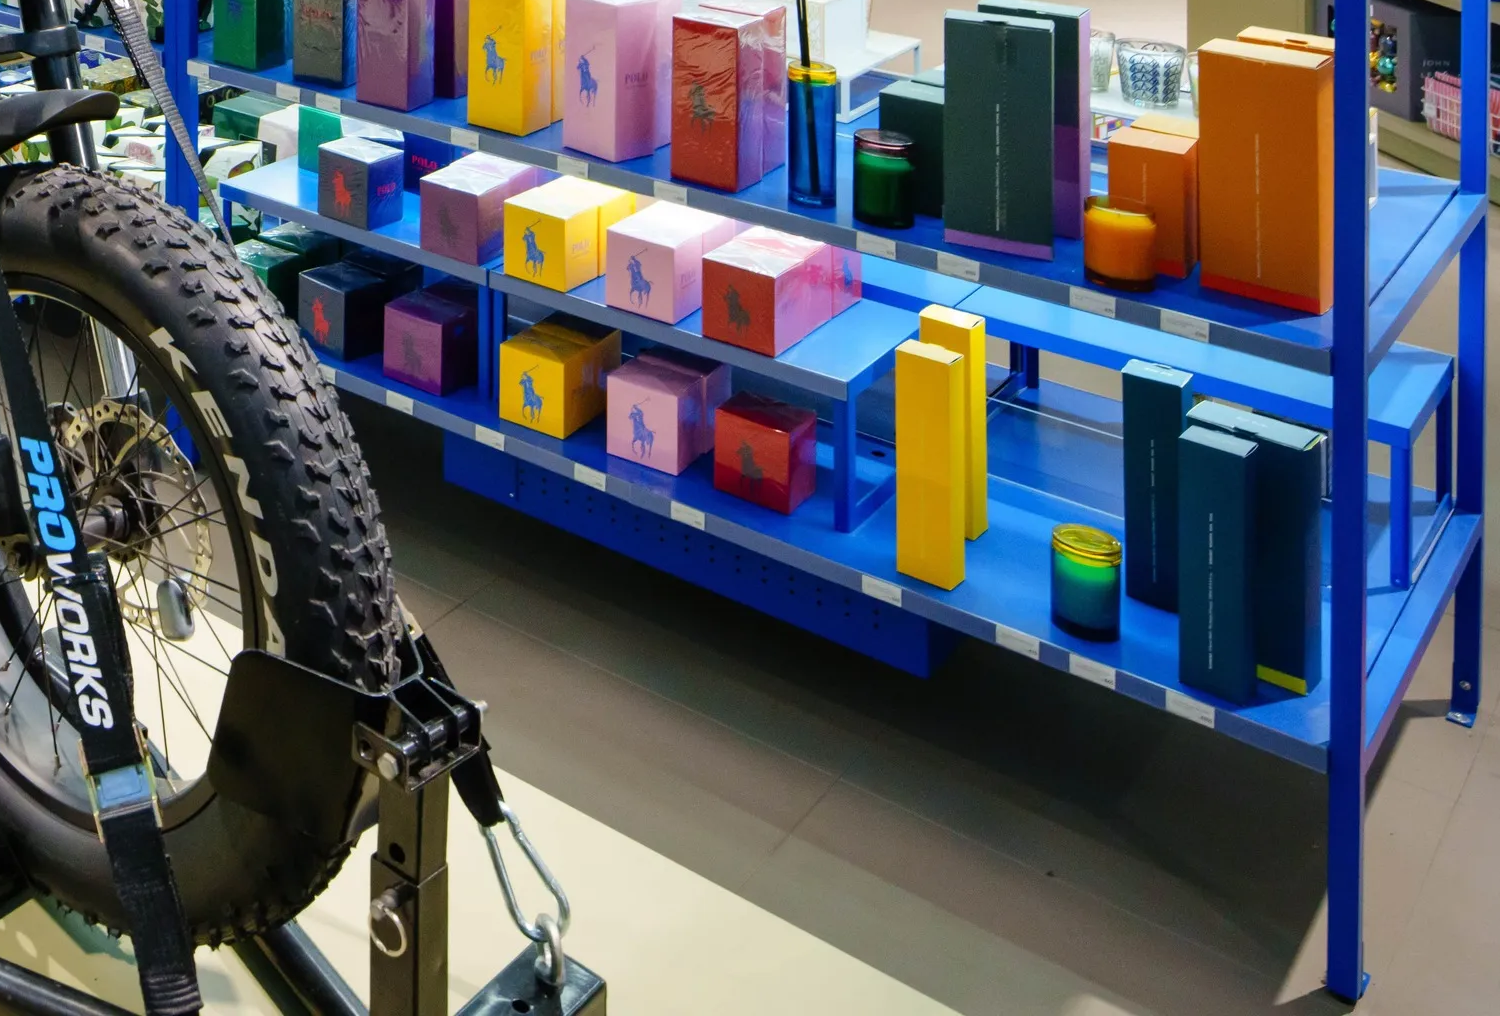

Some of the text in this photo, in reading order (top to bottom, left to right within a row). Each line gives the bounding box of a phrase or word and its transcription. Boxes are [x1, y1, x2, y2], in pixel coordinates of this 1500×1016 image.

[624, 72, 648, 84] POLO
[411, 155, 438, 170] POLO
[376, 181, 396, 197] POLO
[150, 326, 286, 658] KENDA
